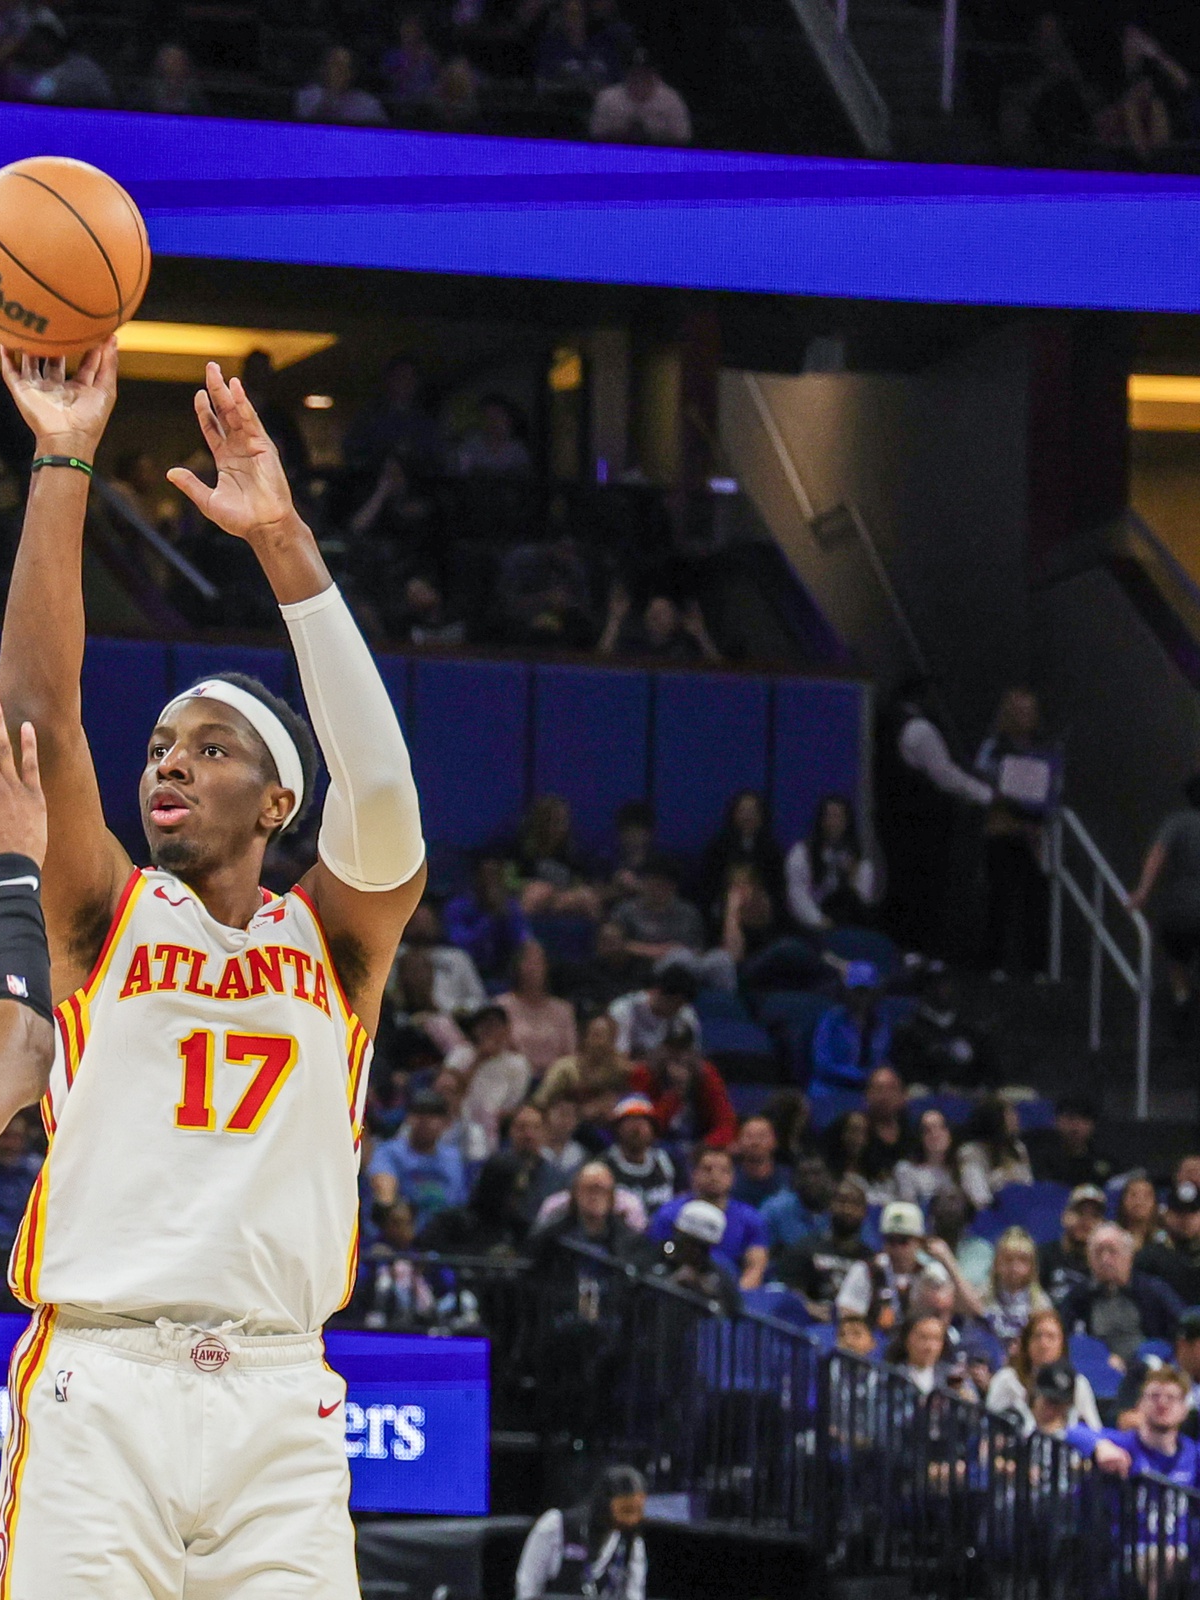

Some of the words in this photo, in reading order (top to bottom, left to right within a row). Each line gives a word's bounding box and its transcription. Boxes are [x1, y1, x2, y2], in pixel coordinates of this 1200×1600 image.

[118, 943, 332, 1021] ATLANTA
[174, 1028, 299, 1133] 17
[190, 1348, 230, 1361] HAWKS
